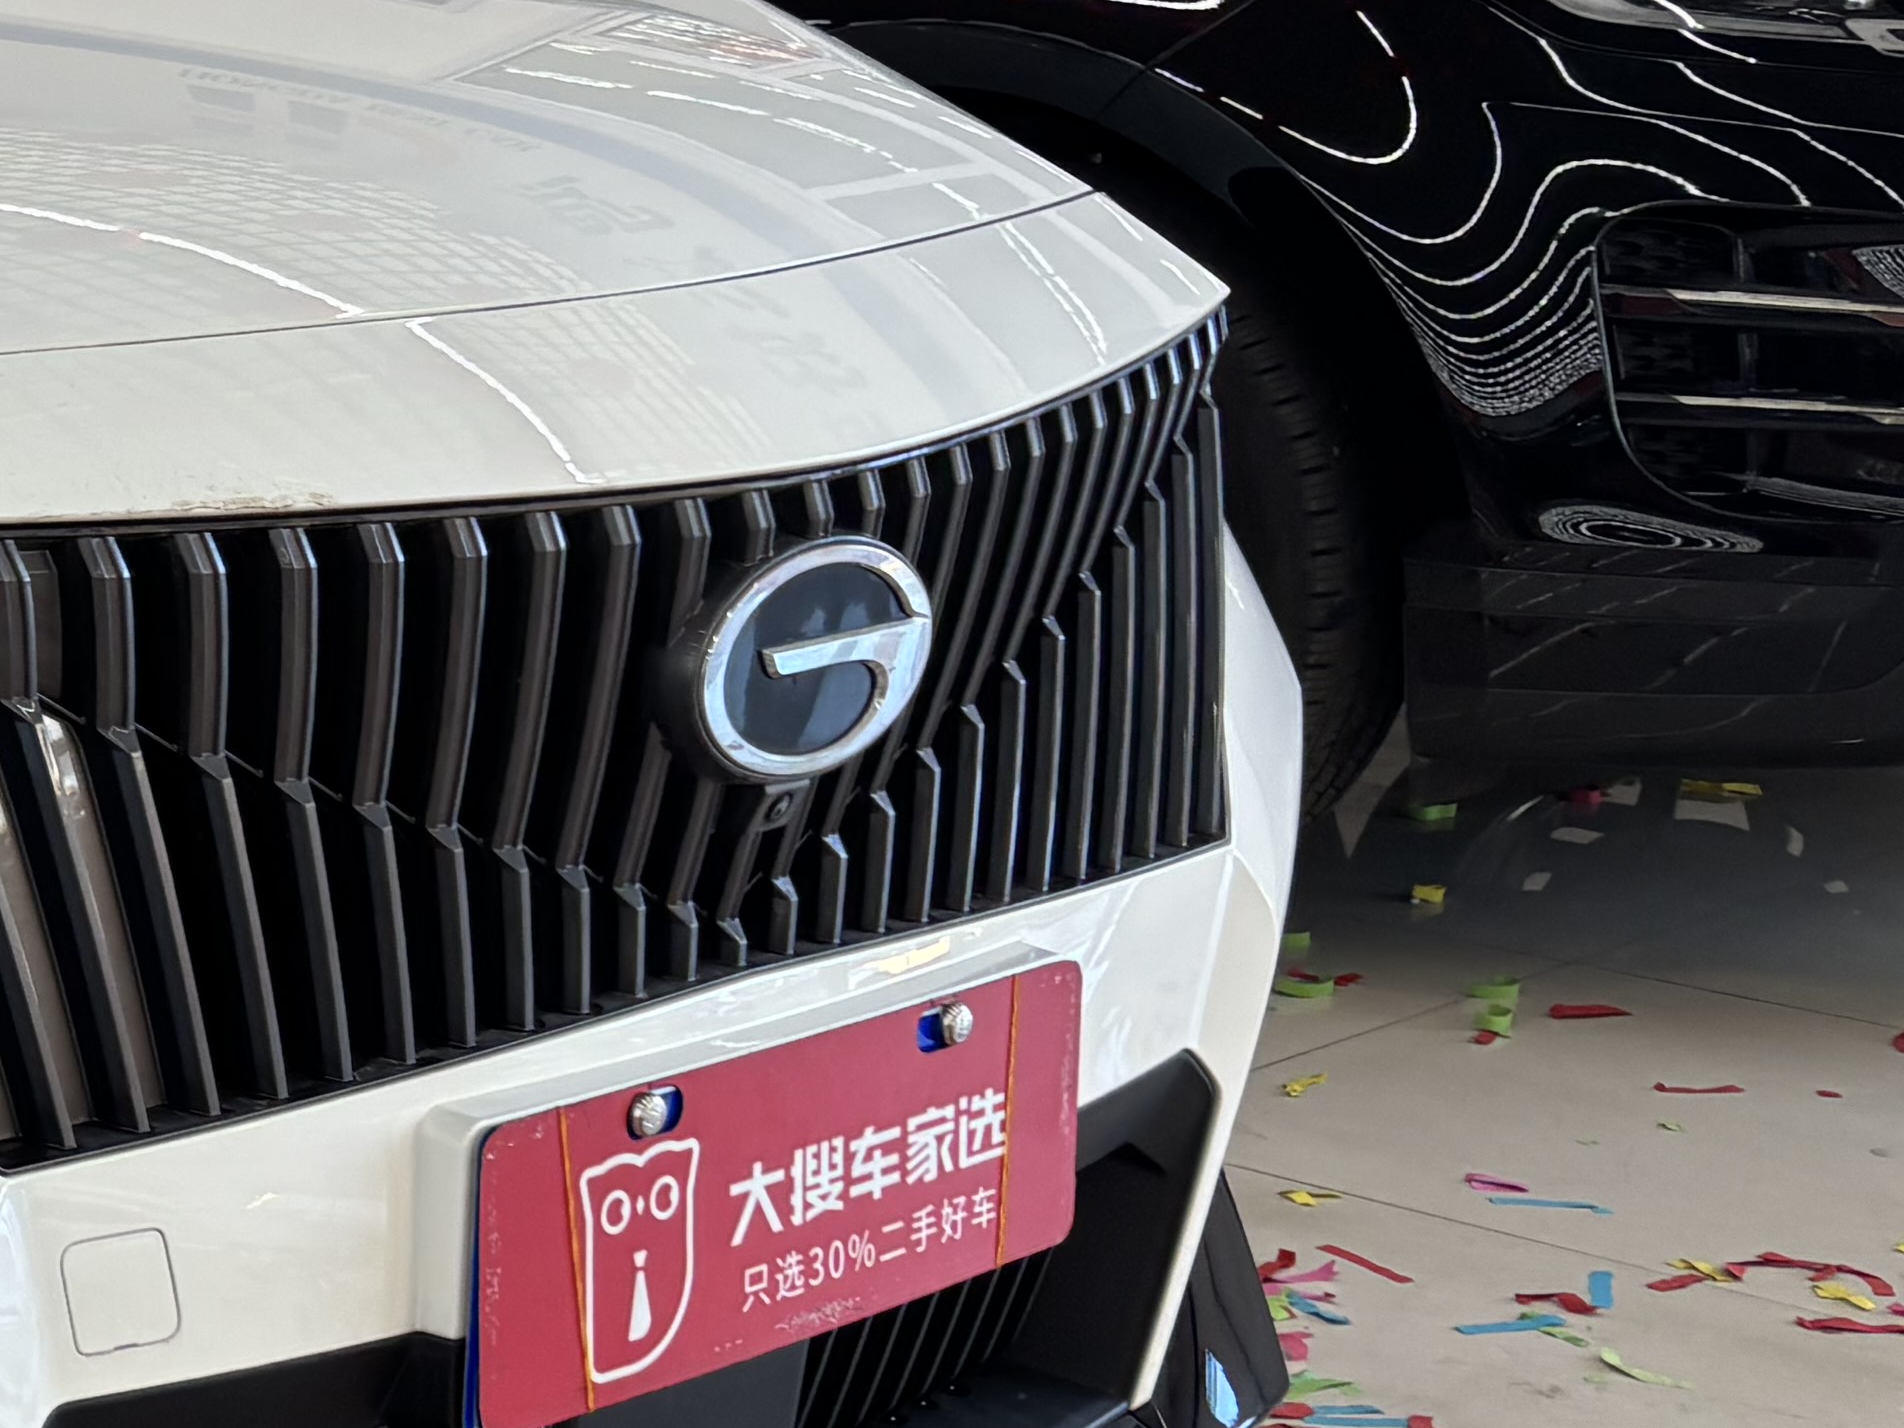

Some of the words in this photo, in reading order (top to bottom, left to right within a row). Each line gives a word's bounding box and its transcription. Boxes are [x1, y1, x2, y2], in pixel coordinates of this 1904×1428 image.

[728, 1086, 1008, 1248] 大搜车家选
[741, 1185, 998, 1314] 只选30%二手好车
